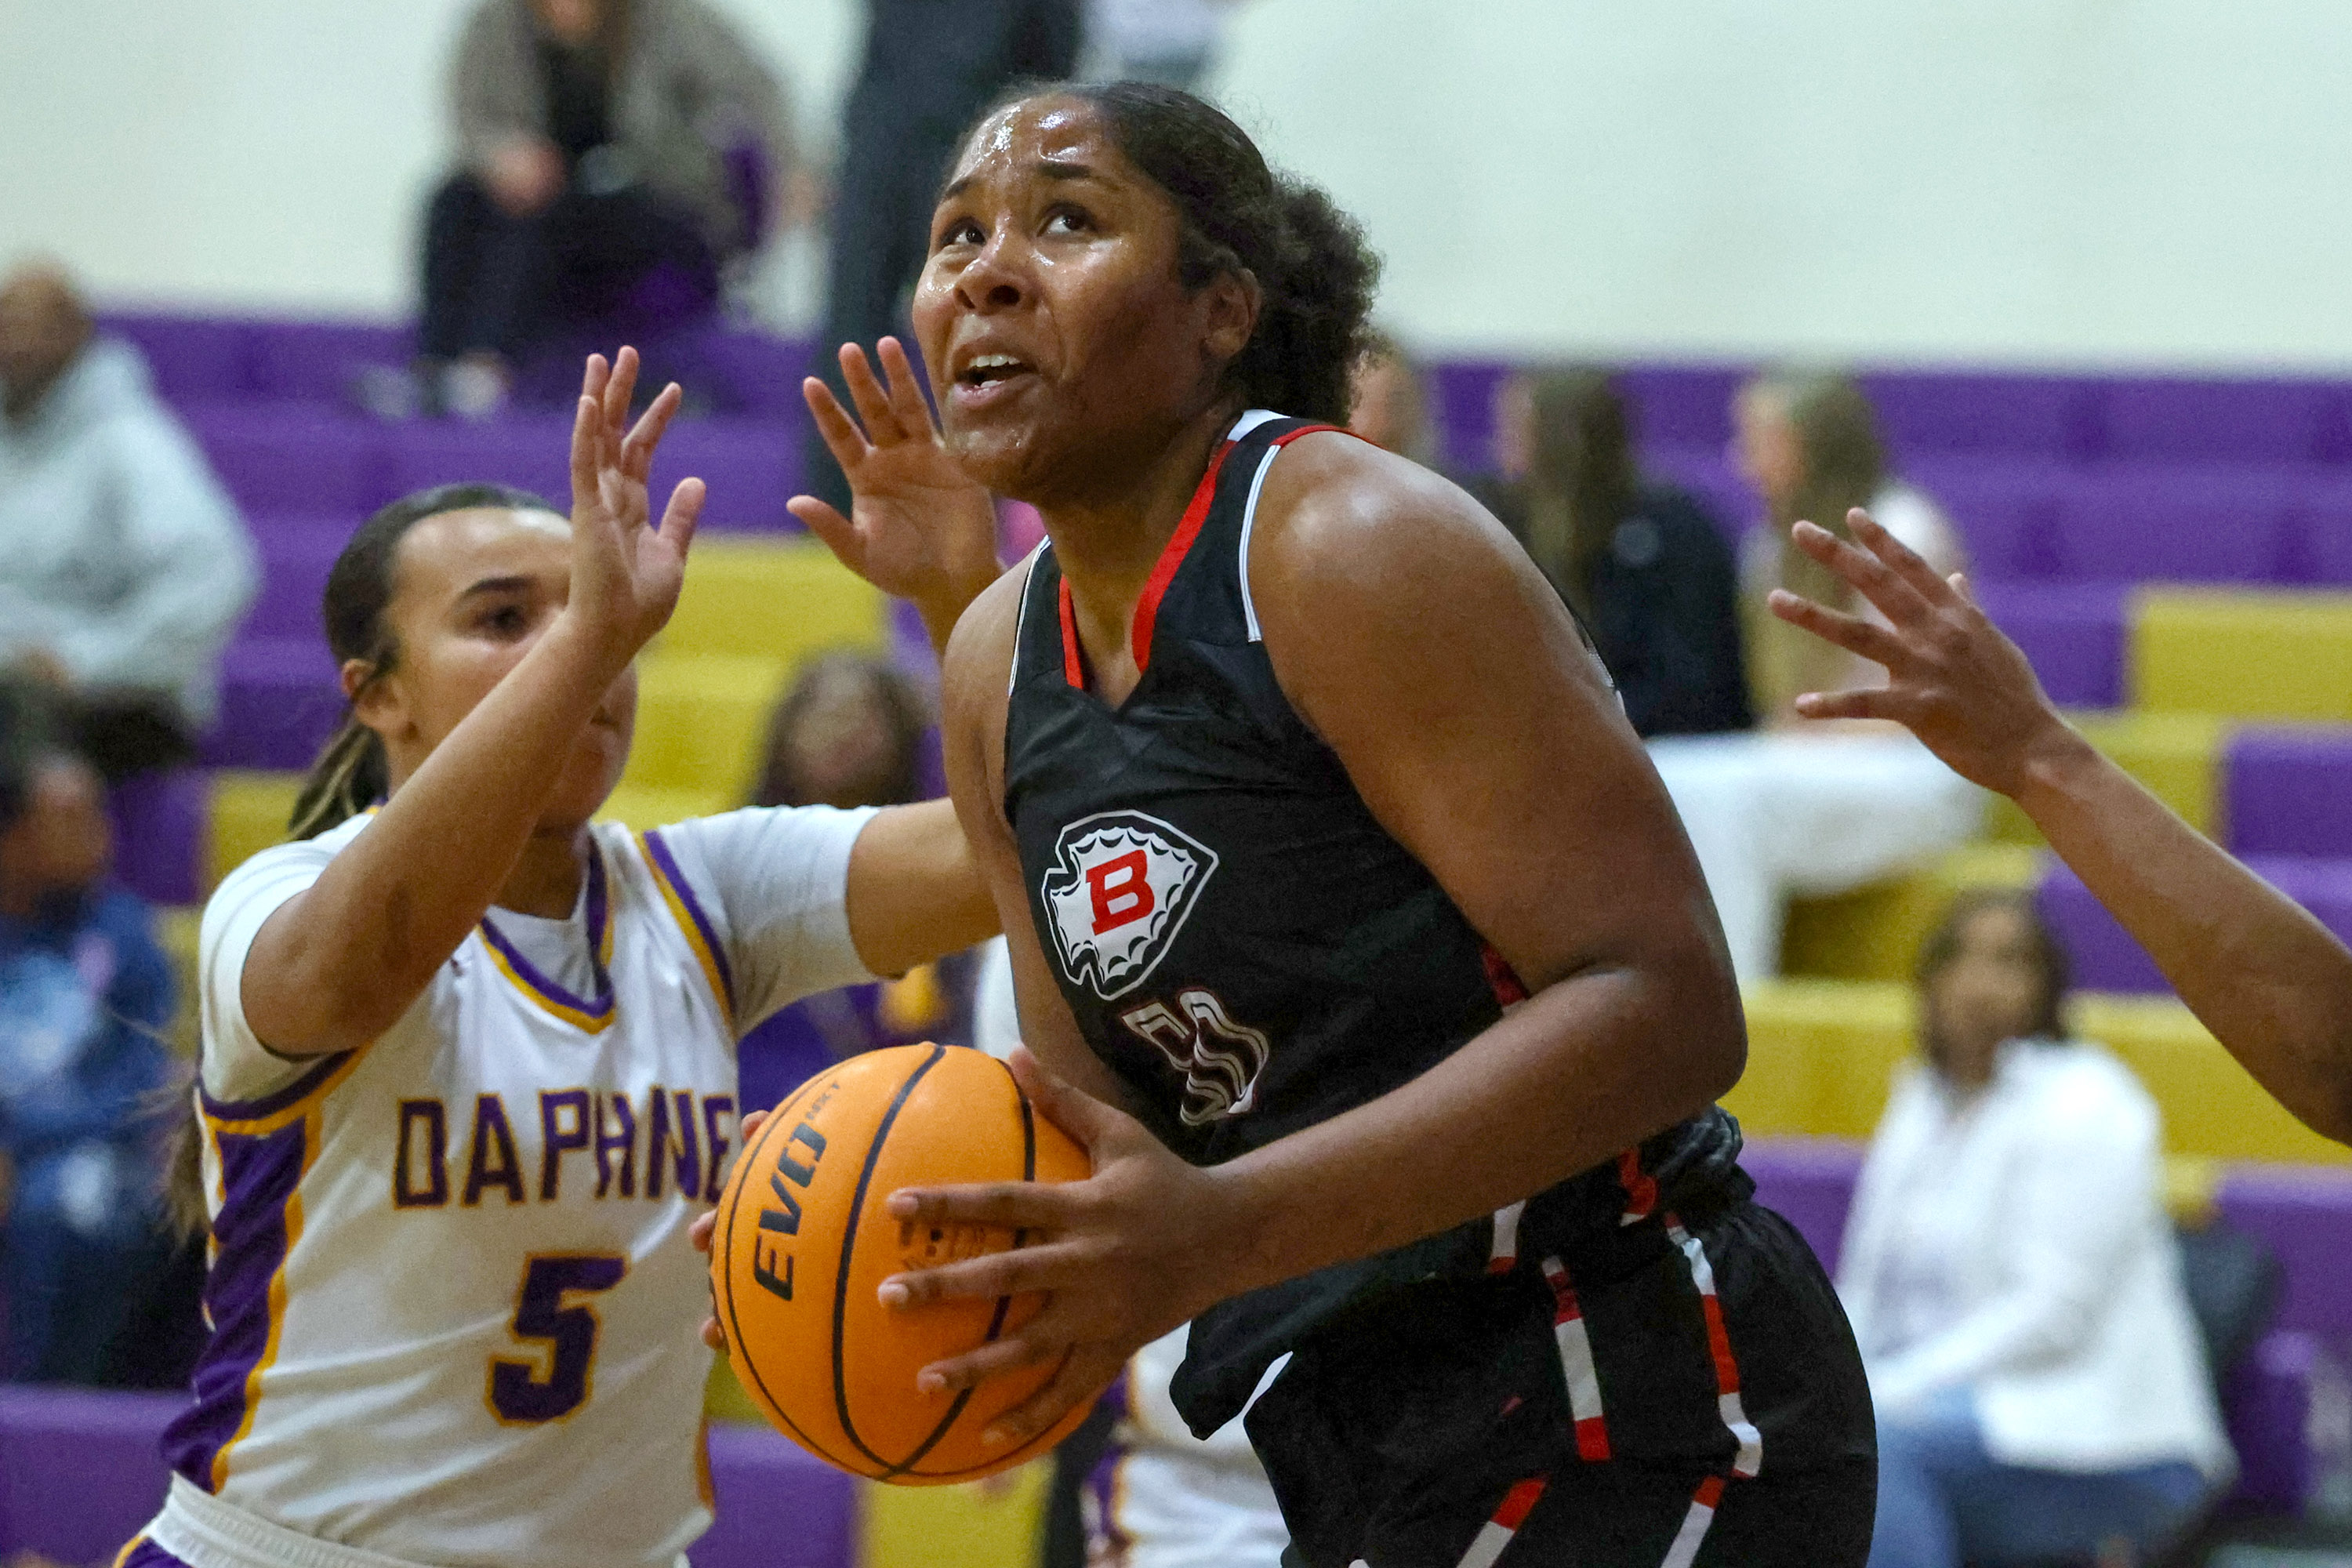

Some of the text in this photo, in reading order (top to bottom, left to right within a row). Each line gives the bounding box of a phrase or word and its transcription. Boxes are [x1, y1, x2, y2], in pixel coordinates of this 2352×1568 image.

[1085, 849, 1156, 936] B
[394, 1085, 735, 1210] DAPHNE
[753, 1122, 828, 1302] EVO
[484, 1251, 629, 1427] 5
